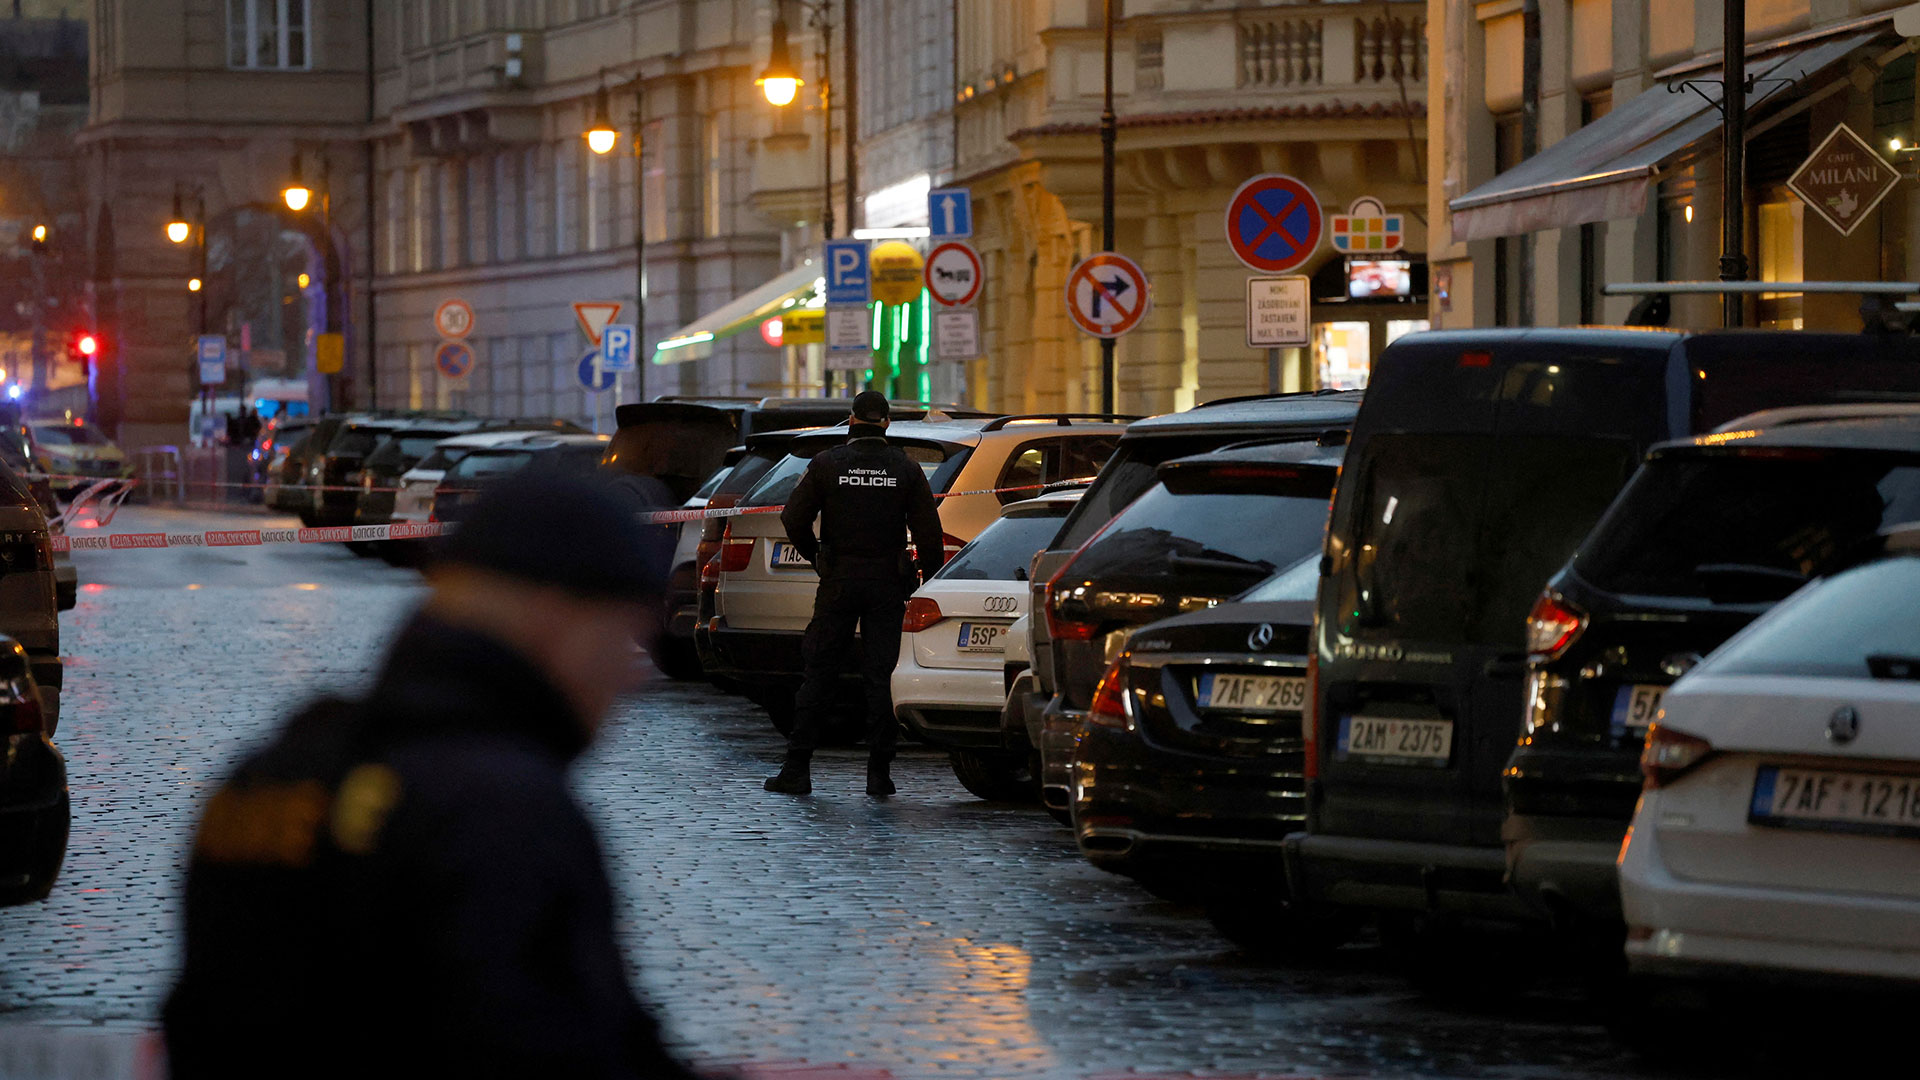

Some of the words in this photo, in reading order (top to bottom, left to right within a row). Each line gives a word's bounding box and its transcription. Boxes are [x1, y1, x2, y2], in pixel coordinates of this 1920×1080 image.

[1810, 166, 1877, 185] MILANI
[833, 248, 861, 286] P
[608, 330, 628, 357] P
[839, 476, 897, 486] POLICIE
[971, 627, 998, 645] 5SP
[1216, 678, 1255, 705] 7AF
[1352, 722, 1387, 750] 2AM
[1398, 725, 1445, 752] 2375
[1780, 775, 1838, 812] 7AF
